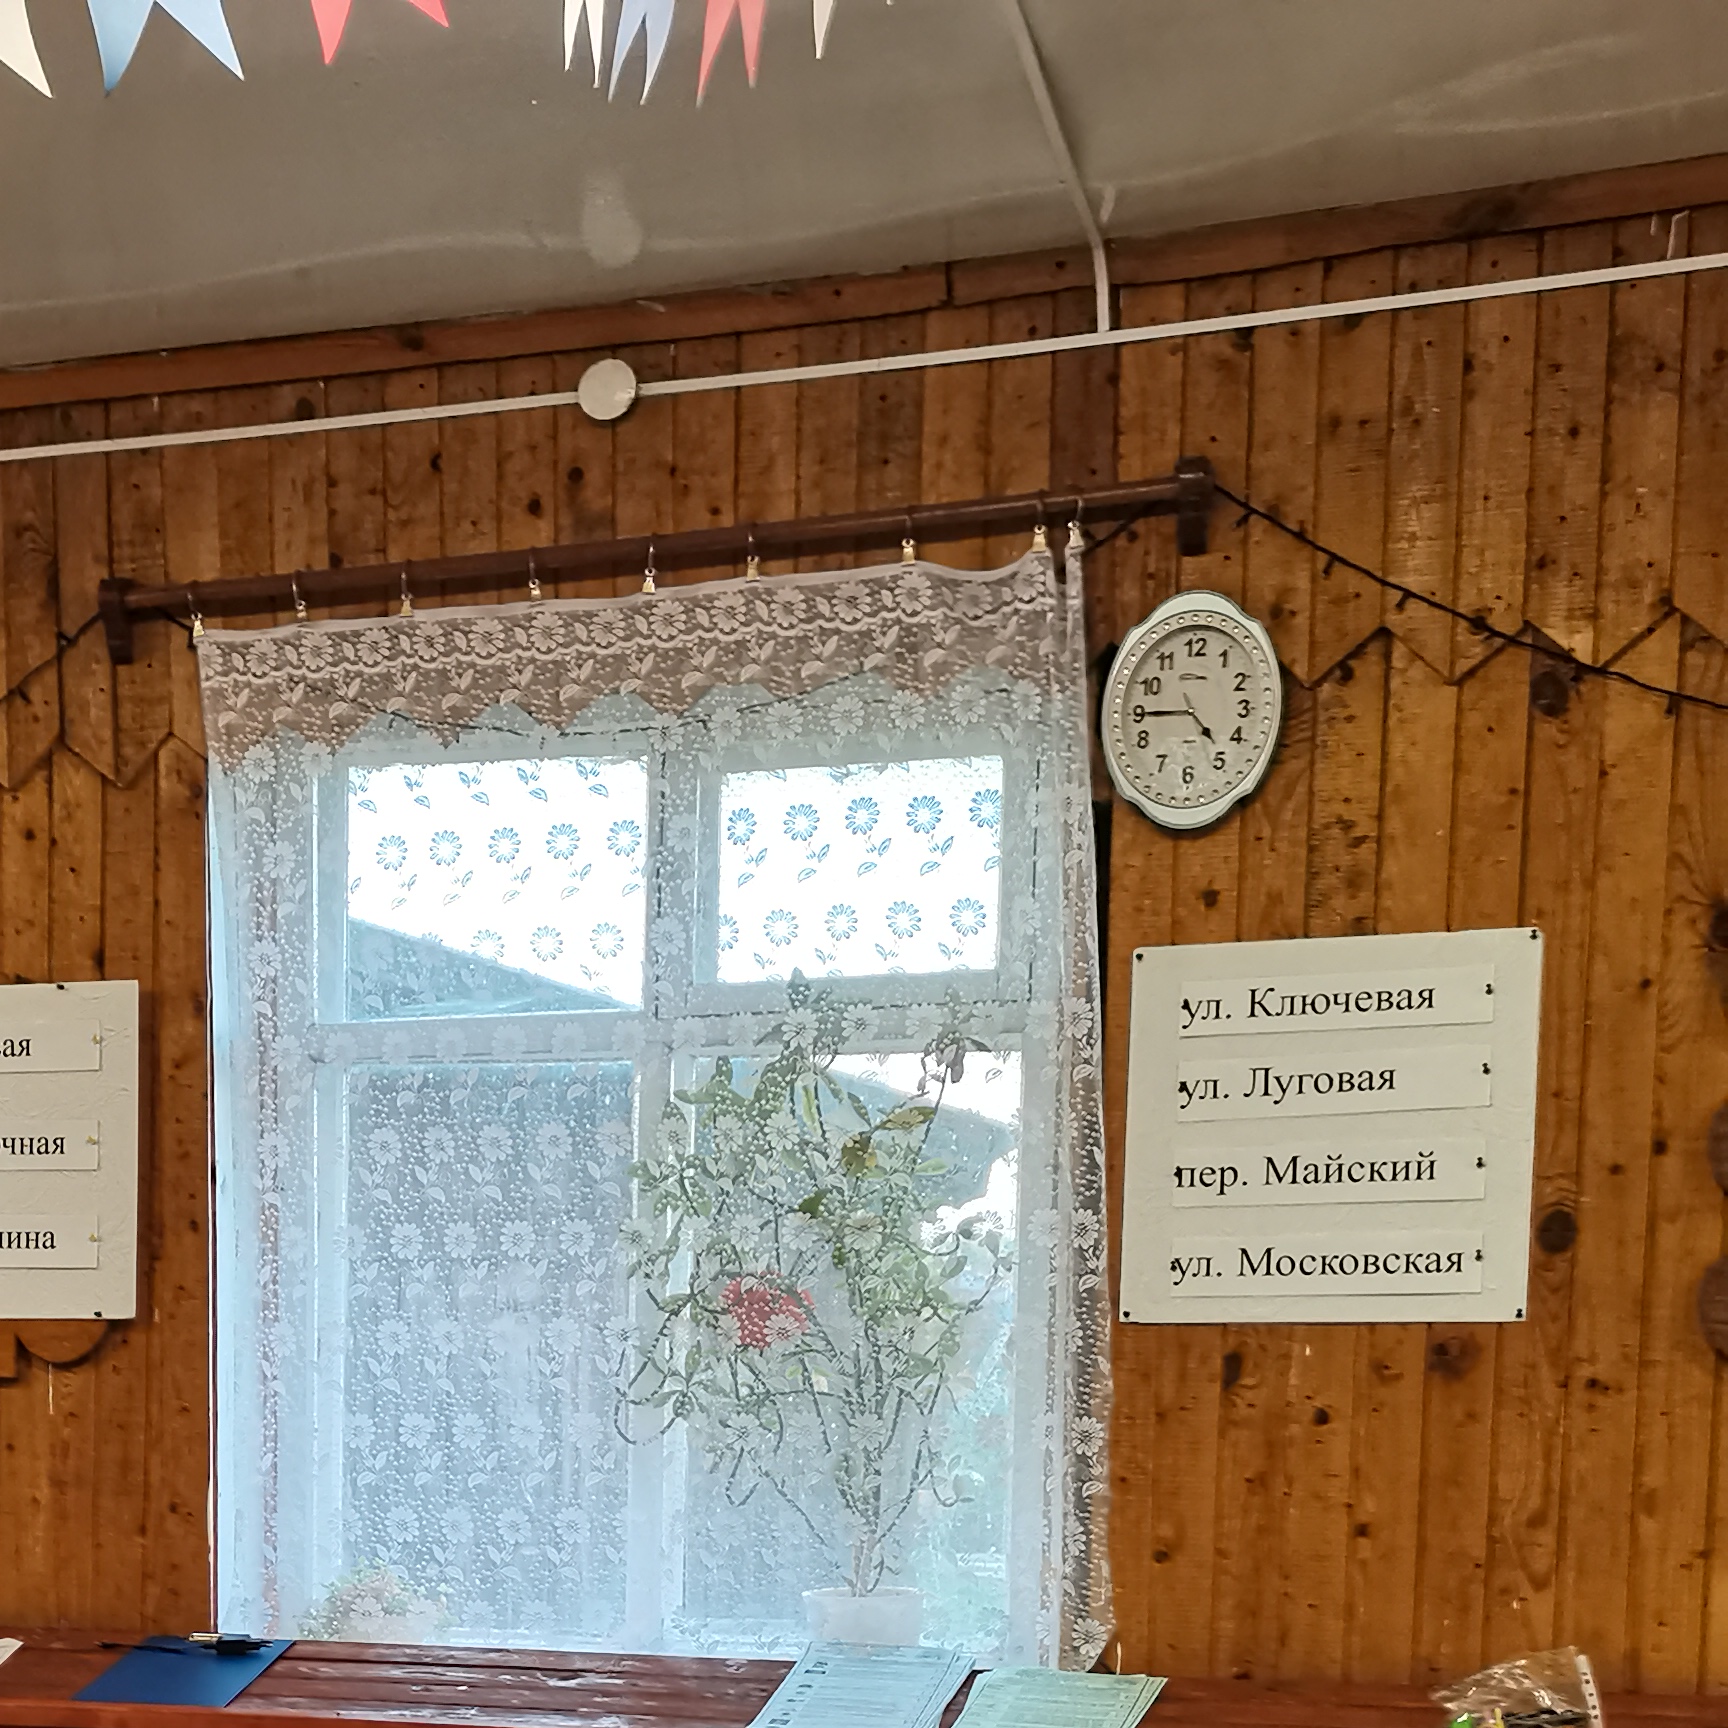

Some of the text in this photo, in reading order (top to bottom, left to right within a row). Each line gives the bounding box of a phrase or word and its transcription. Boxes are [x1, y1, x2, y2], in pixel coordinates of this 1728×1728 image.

[1184, 638, 1207, 657] 12
[1157, 651, 1174, 671] 11
[1219, 649, 1228, 668] 1
[1140, 677, 1161, 695] 10
[1233, 673, 1246, 692] 2
[1133, 705, 1146, 723] 9
[1237, 699, 1250, 718] 3
[1137, 730, 1149, 749] 8
[1230, 726, 1243, 744] 4
[1156, 754, 1168, 773] 7
[1213, 752, 1226, 770] 5
[1182, 766, 1194, 784] 6
[1183, 986, 1435, 1029] ул. Ключевая
[1179, 1067, 1396, 1109] ул. Луговая
[1174, 1151, 1437, 1195] пер. Майский
[1172, 1246, 1464, 1286] ул. Московская
